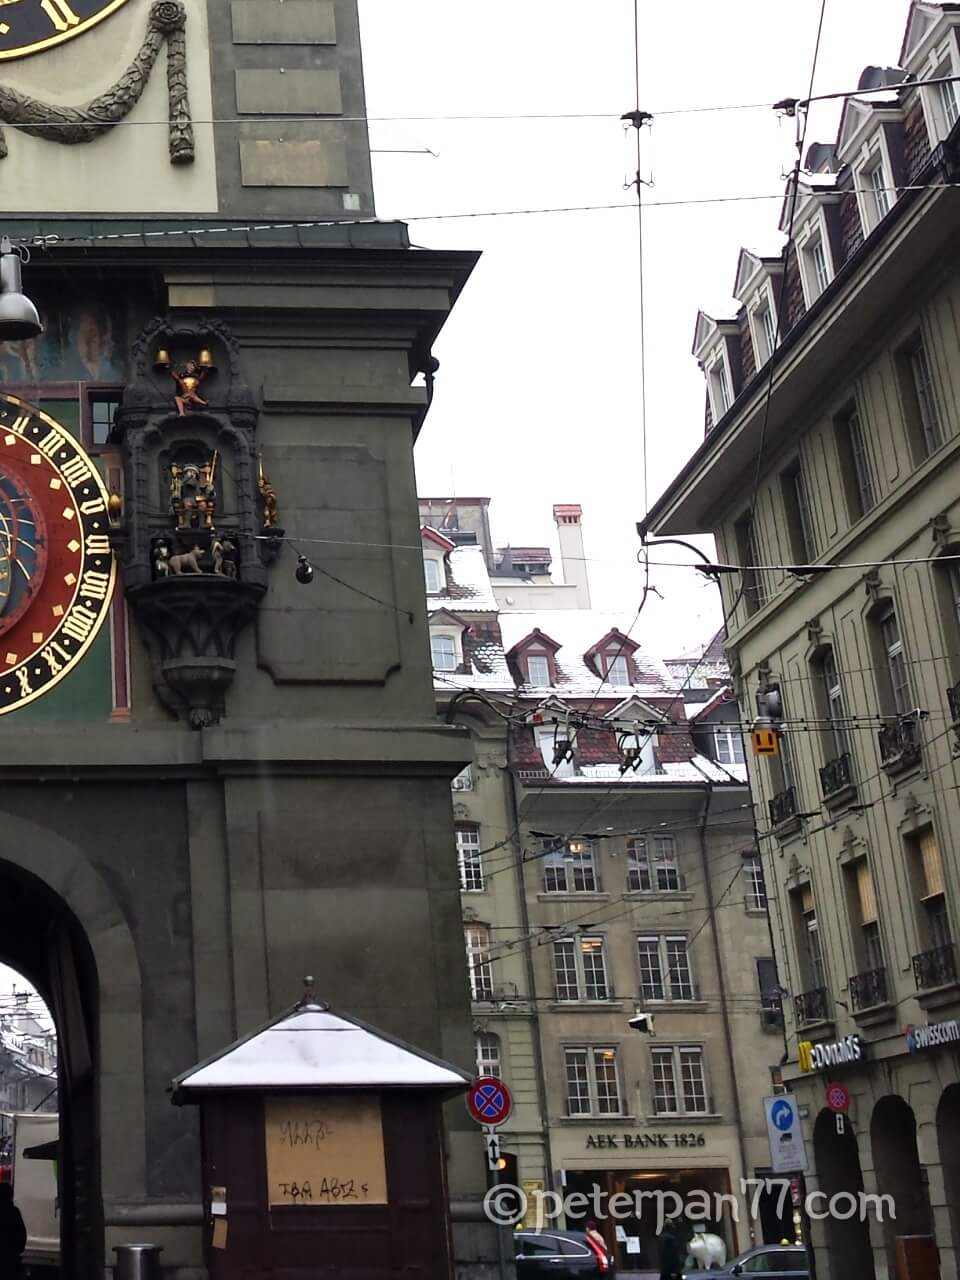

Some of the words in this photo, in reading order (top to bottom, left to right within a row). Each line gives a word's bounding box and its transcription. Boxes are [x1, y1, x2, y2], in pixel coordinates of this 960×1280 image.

[915, 1020, 960, 1049] swisscom
[586, 1134, 618, 1149] AEK
[624, 1133, 668, 1149] BANK
[674, 1133, 706, 1148] 1826
